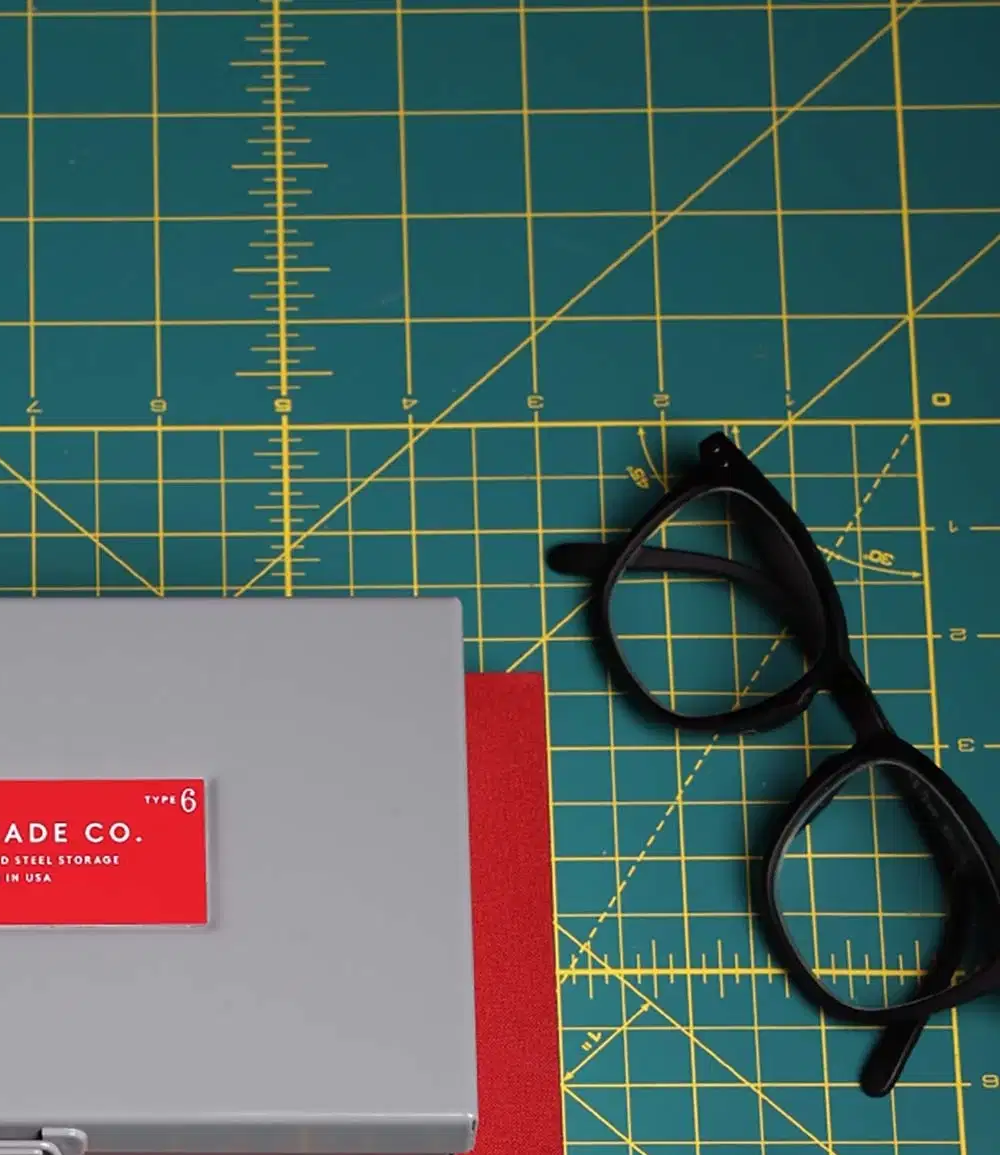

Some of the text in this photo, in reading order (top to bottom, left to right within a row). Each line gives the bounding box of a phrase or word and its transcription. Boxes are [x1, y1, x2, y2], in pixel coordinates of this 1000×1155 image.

[26, 400, 43, 413] 7
[274, 397, 293, 412] 5
[402, 397, 417, 410] 4
[527, 394, 542, 409] 3
[654, 393, 670, 408] 2
[950, 627, 967, 641] 2
[956, 738, 975, 752] 3
[144, 788, 198, 813] TYPE 6
[84, 822, 144, 844] CO.
[15, 855, 53, 866] STEEL
[58, 855, 120, 866] STORAGE
[5, 873, 20, 883] IN
[25, 873, 53, 883] USA
